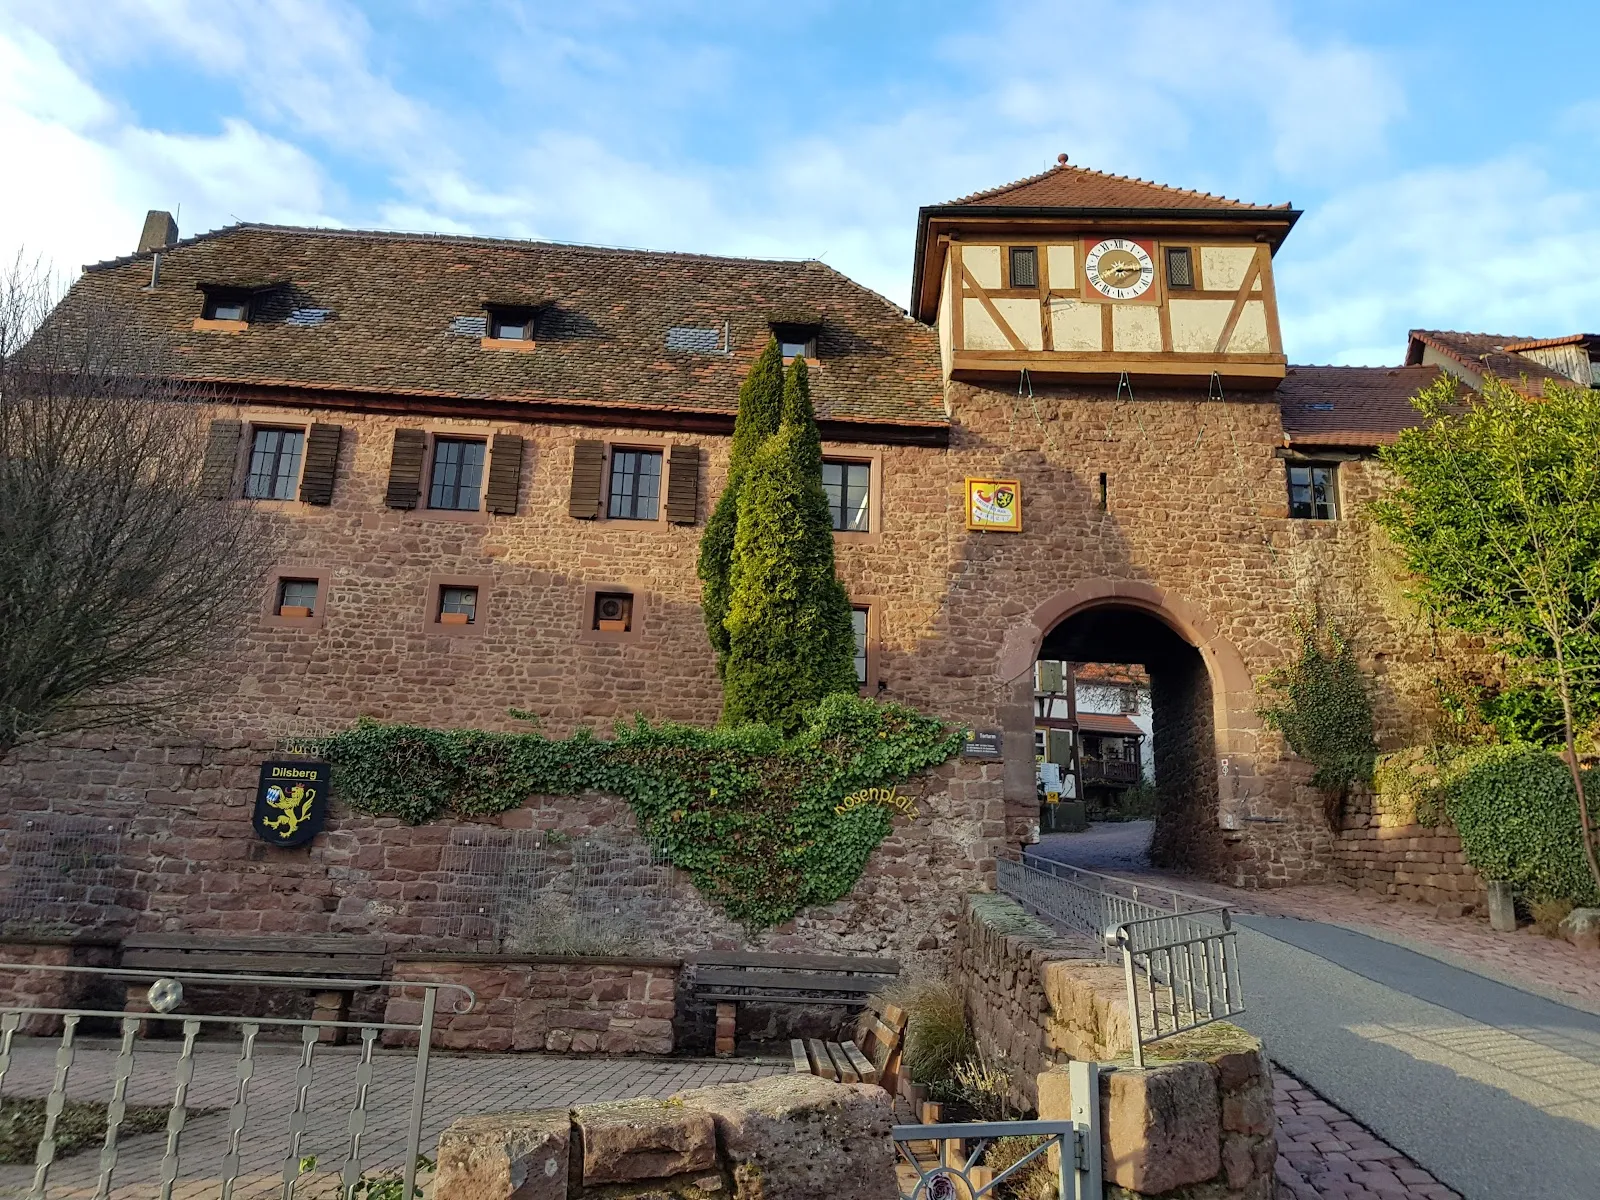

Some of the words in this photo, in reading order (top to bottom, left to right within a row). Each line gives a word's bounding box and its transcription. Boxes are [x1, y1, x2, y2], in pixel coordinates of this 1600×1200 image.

[1100, 242, 1110, 252] XI
[1114, 239, 1124, 249] XII
[1130, 244, 1136, 252] I
[1090, 251, 1100, 260] X
[1090, 274, 1101, 286] VIII
[1141, 278, 1150, 287] IV
[1101, 284, 1111, 295] VII
[1117, 289, 1125, 298] VI
[1132, 288, 1139, 296] V
[272, 767, 318, 780] Dilsberg
